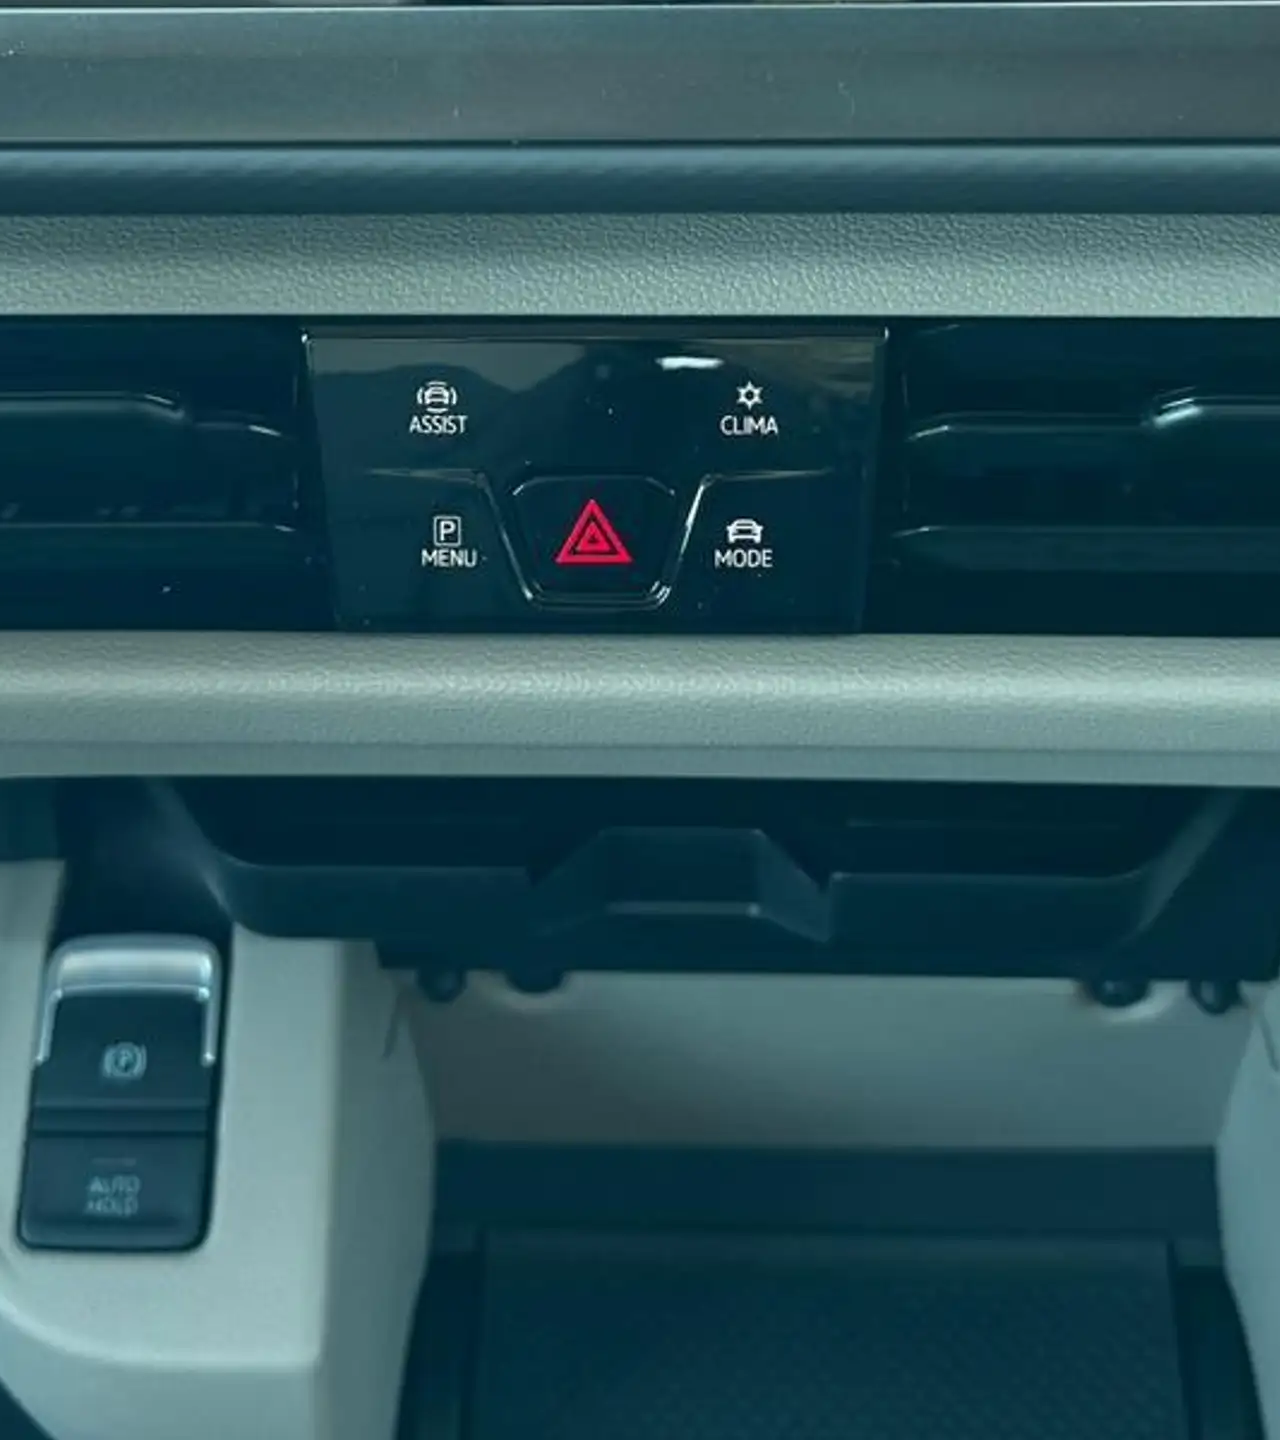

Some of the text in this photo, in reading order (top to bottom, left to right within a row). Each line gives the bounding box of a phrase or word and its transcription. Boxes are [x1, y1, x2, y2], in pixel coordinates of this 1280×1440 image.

[409, 415, 468, 435] ASSIST
[720, 415, 779, 436] CLIMA
[421, 548, 477, 568] MENU
[714, 548, 773, 568] MODE
[88, 1175, 141, 1196] AUTO
